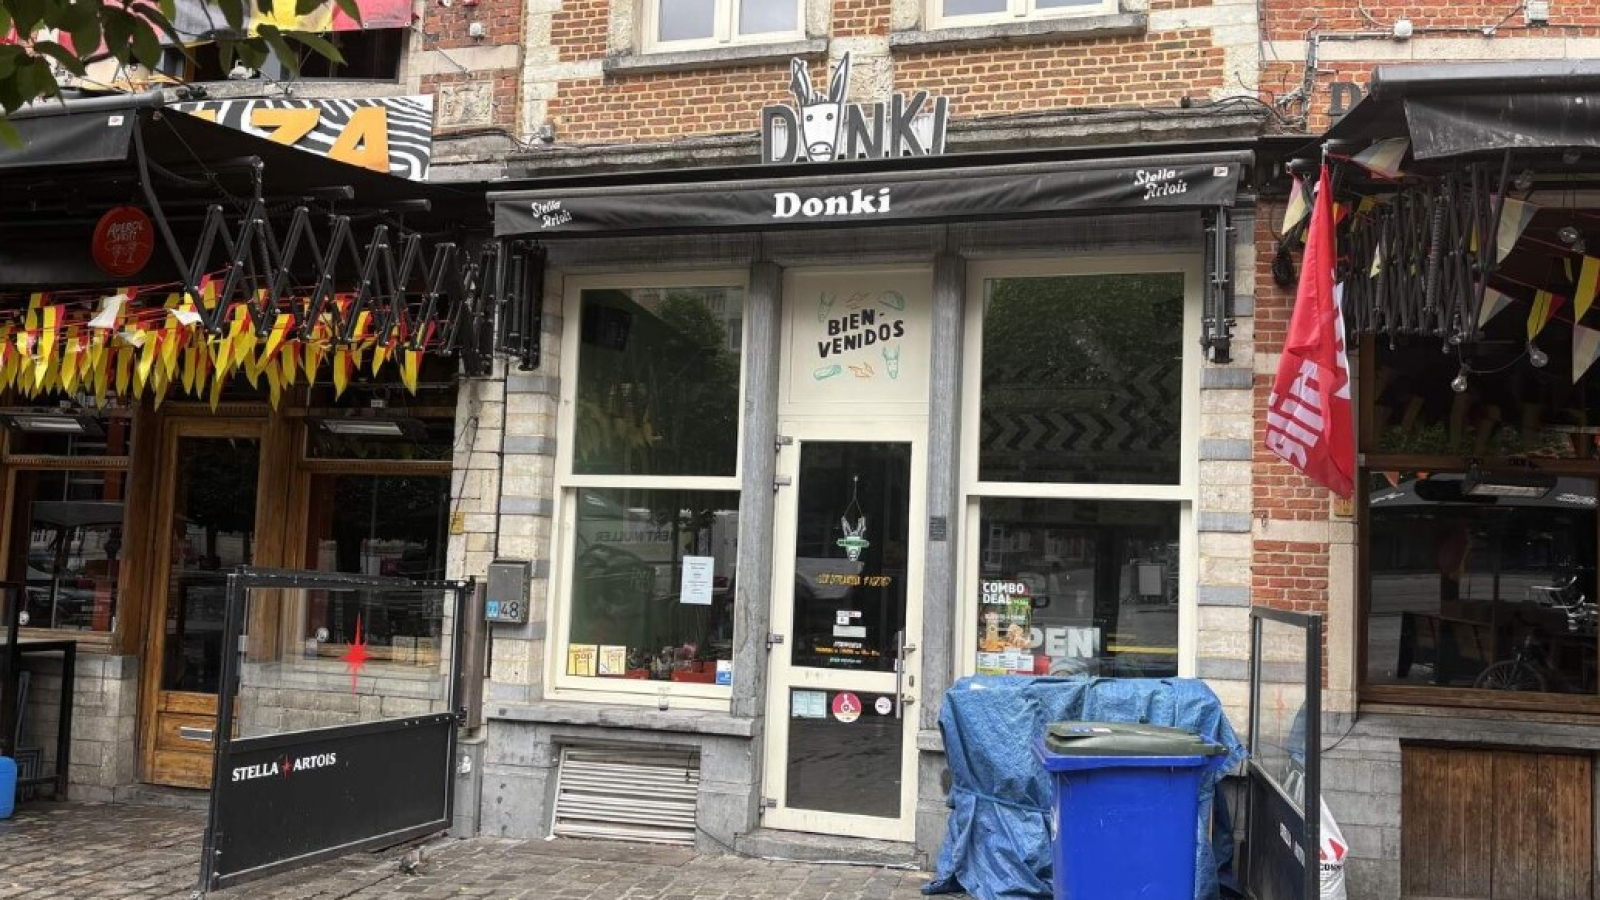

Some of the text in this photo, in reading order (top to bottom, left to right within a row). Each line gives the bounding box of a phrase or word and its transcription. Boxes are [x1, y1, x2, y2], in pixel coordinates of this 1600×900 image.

[1133, 168, 1176, 186] Stella
[1143, 180, 1188, 200] Artois
[531, 200, 561, 218] Stella
[772, 187, 892, 218] Donki
[827, 308, 886, 336] BIEN-
[817, 319, 905, 358] VENIDOS
[982, 582, 1025, 594] COMBO
[982, 593, 1013, 605] DEAL
[500, 600, 519, 618] 48
[231, 752, 337, 782] STELLA ARTOIS
